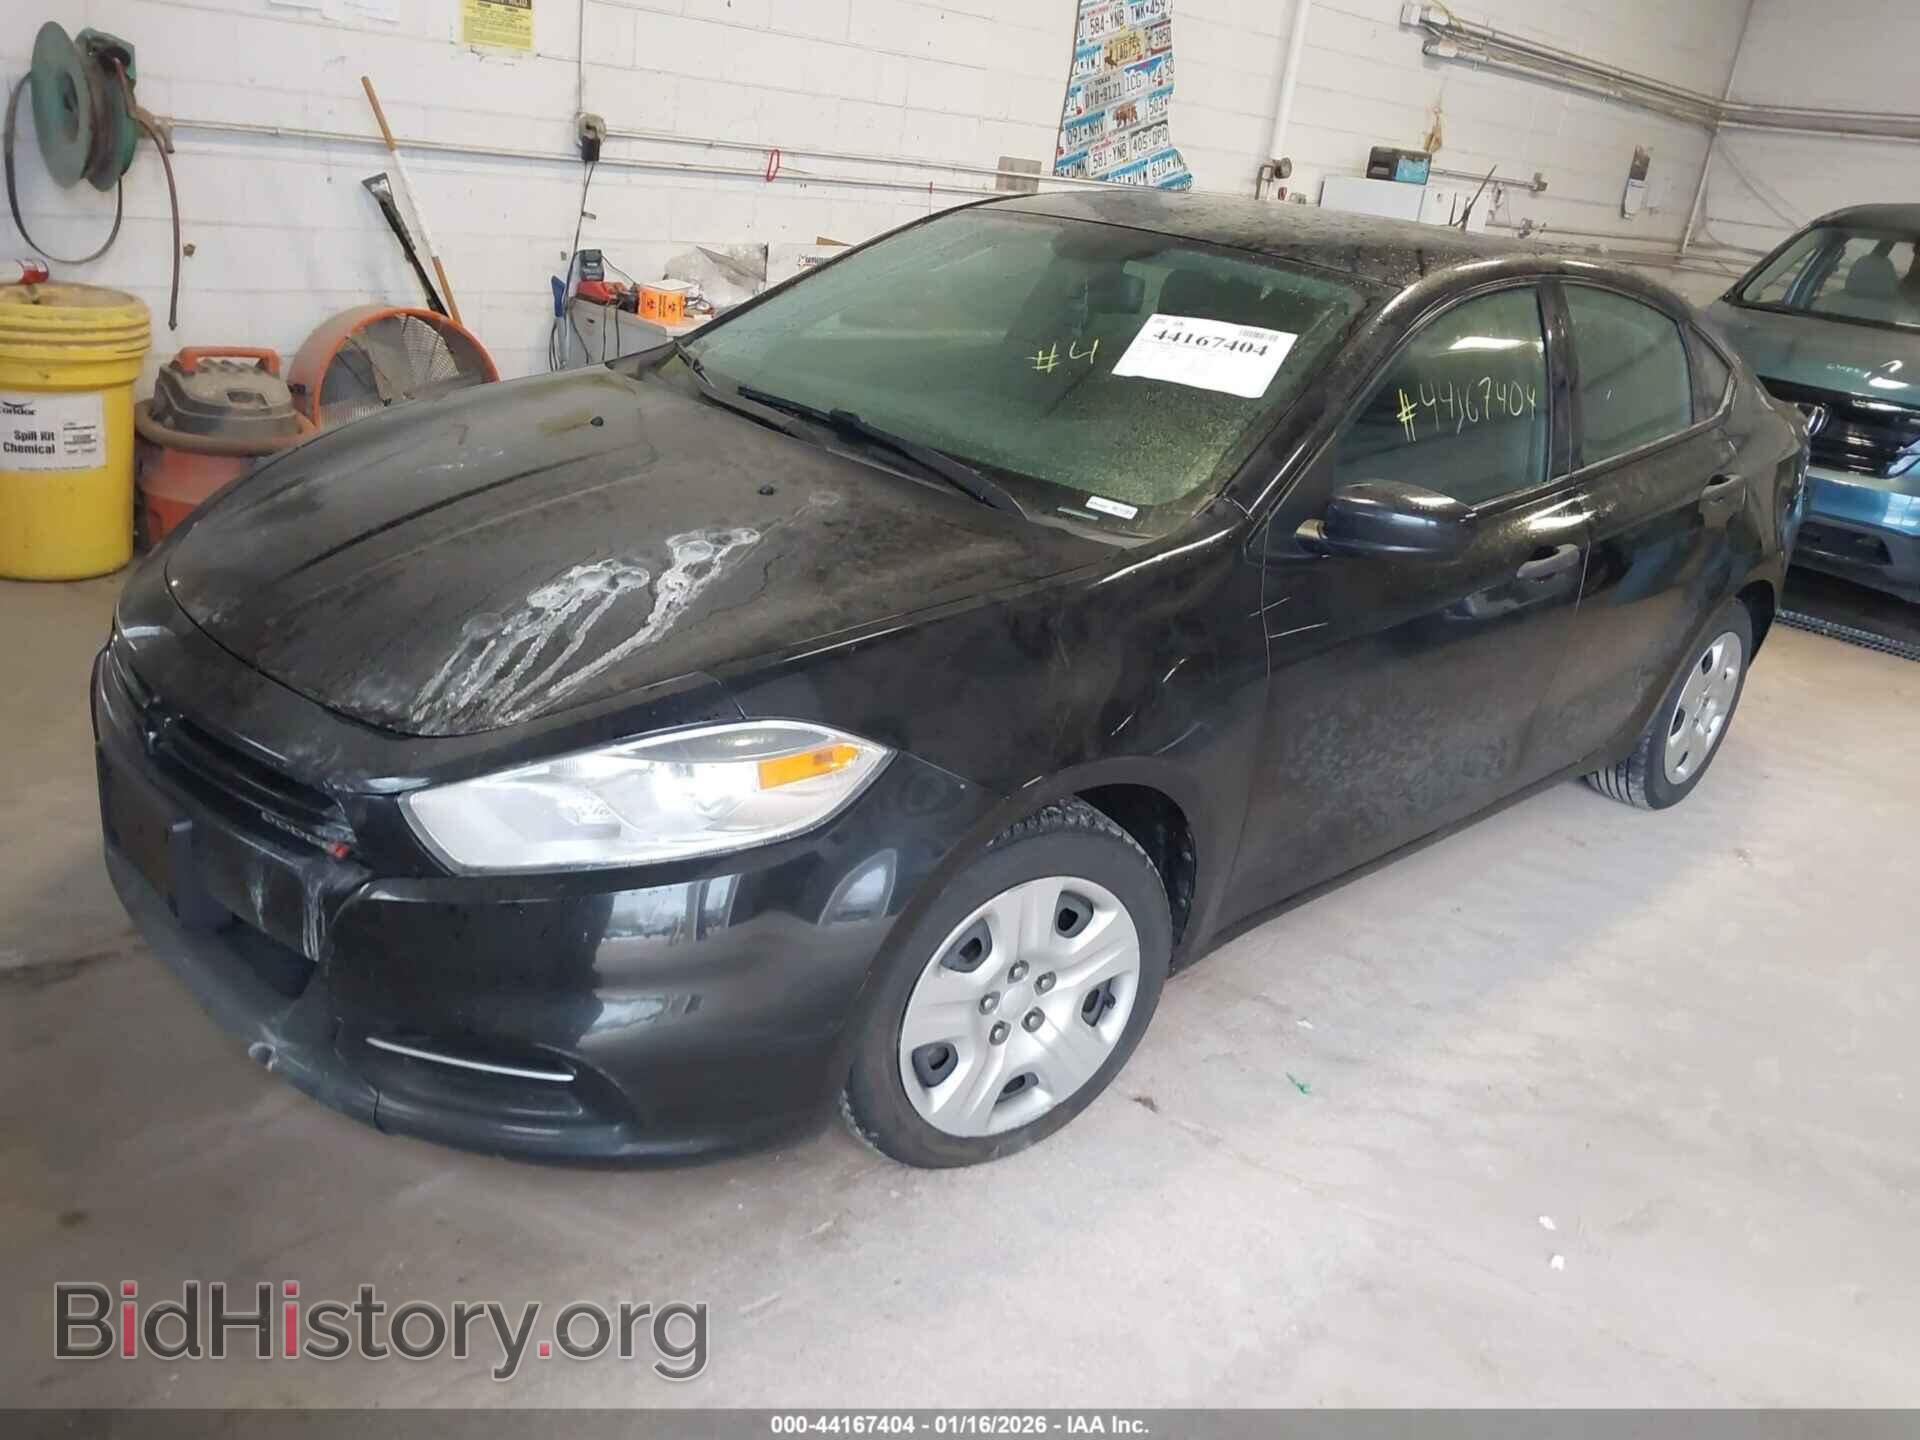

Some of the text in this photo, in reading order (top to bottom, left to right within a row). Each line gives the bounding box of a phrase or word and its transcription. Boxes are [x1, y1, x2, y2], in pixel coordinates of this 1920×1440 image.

[1153, 329, 1268, 356] 44167404
[1396, 376, 1536, 442] #44167404
[14, 430, 55, 442] Spill Kit
[3, 442, 55, 454] Chemical
